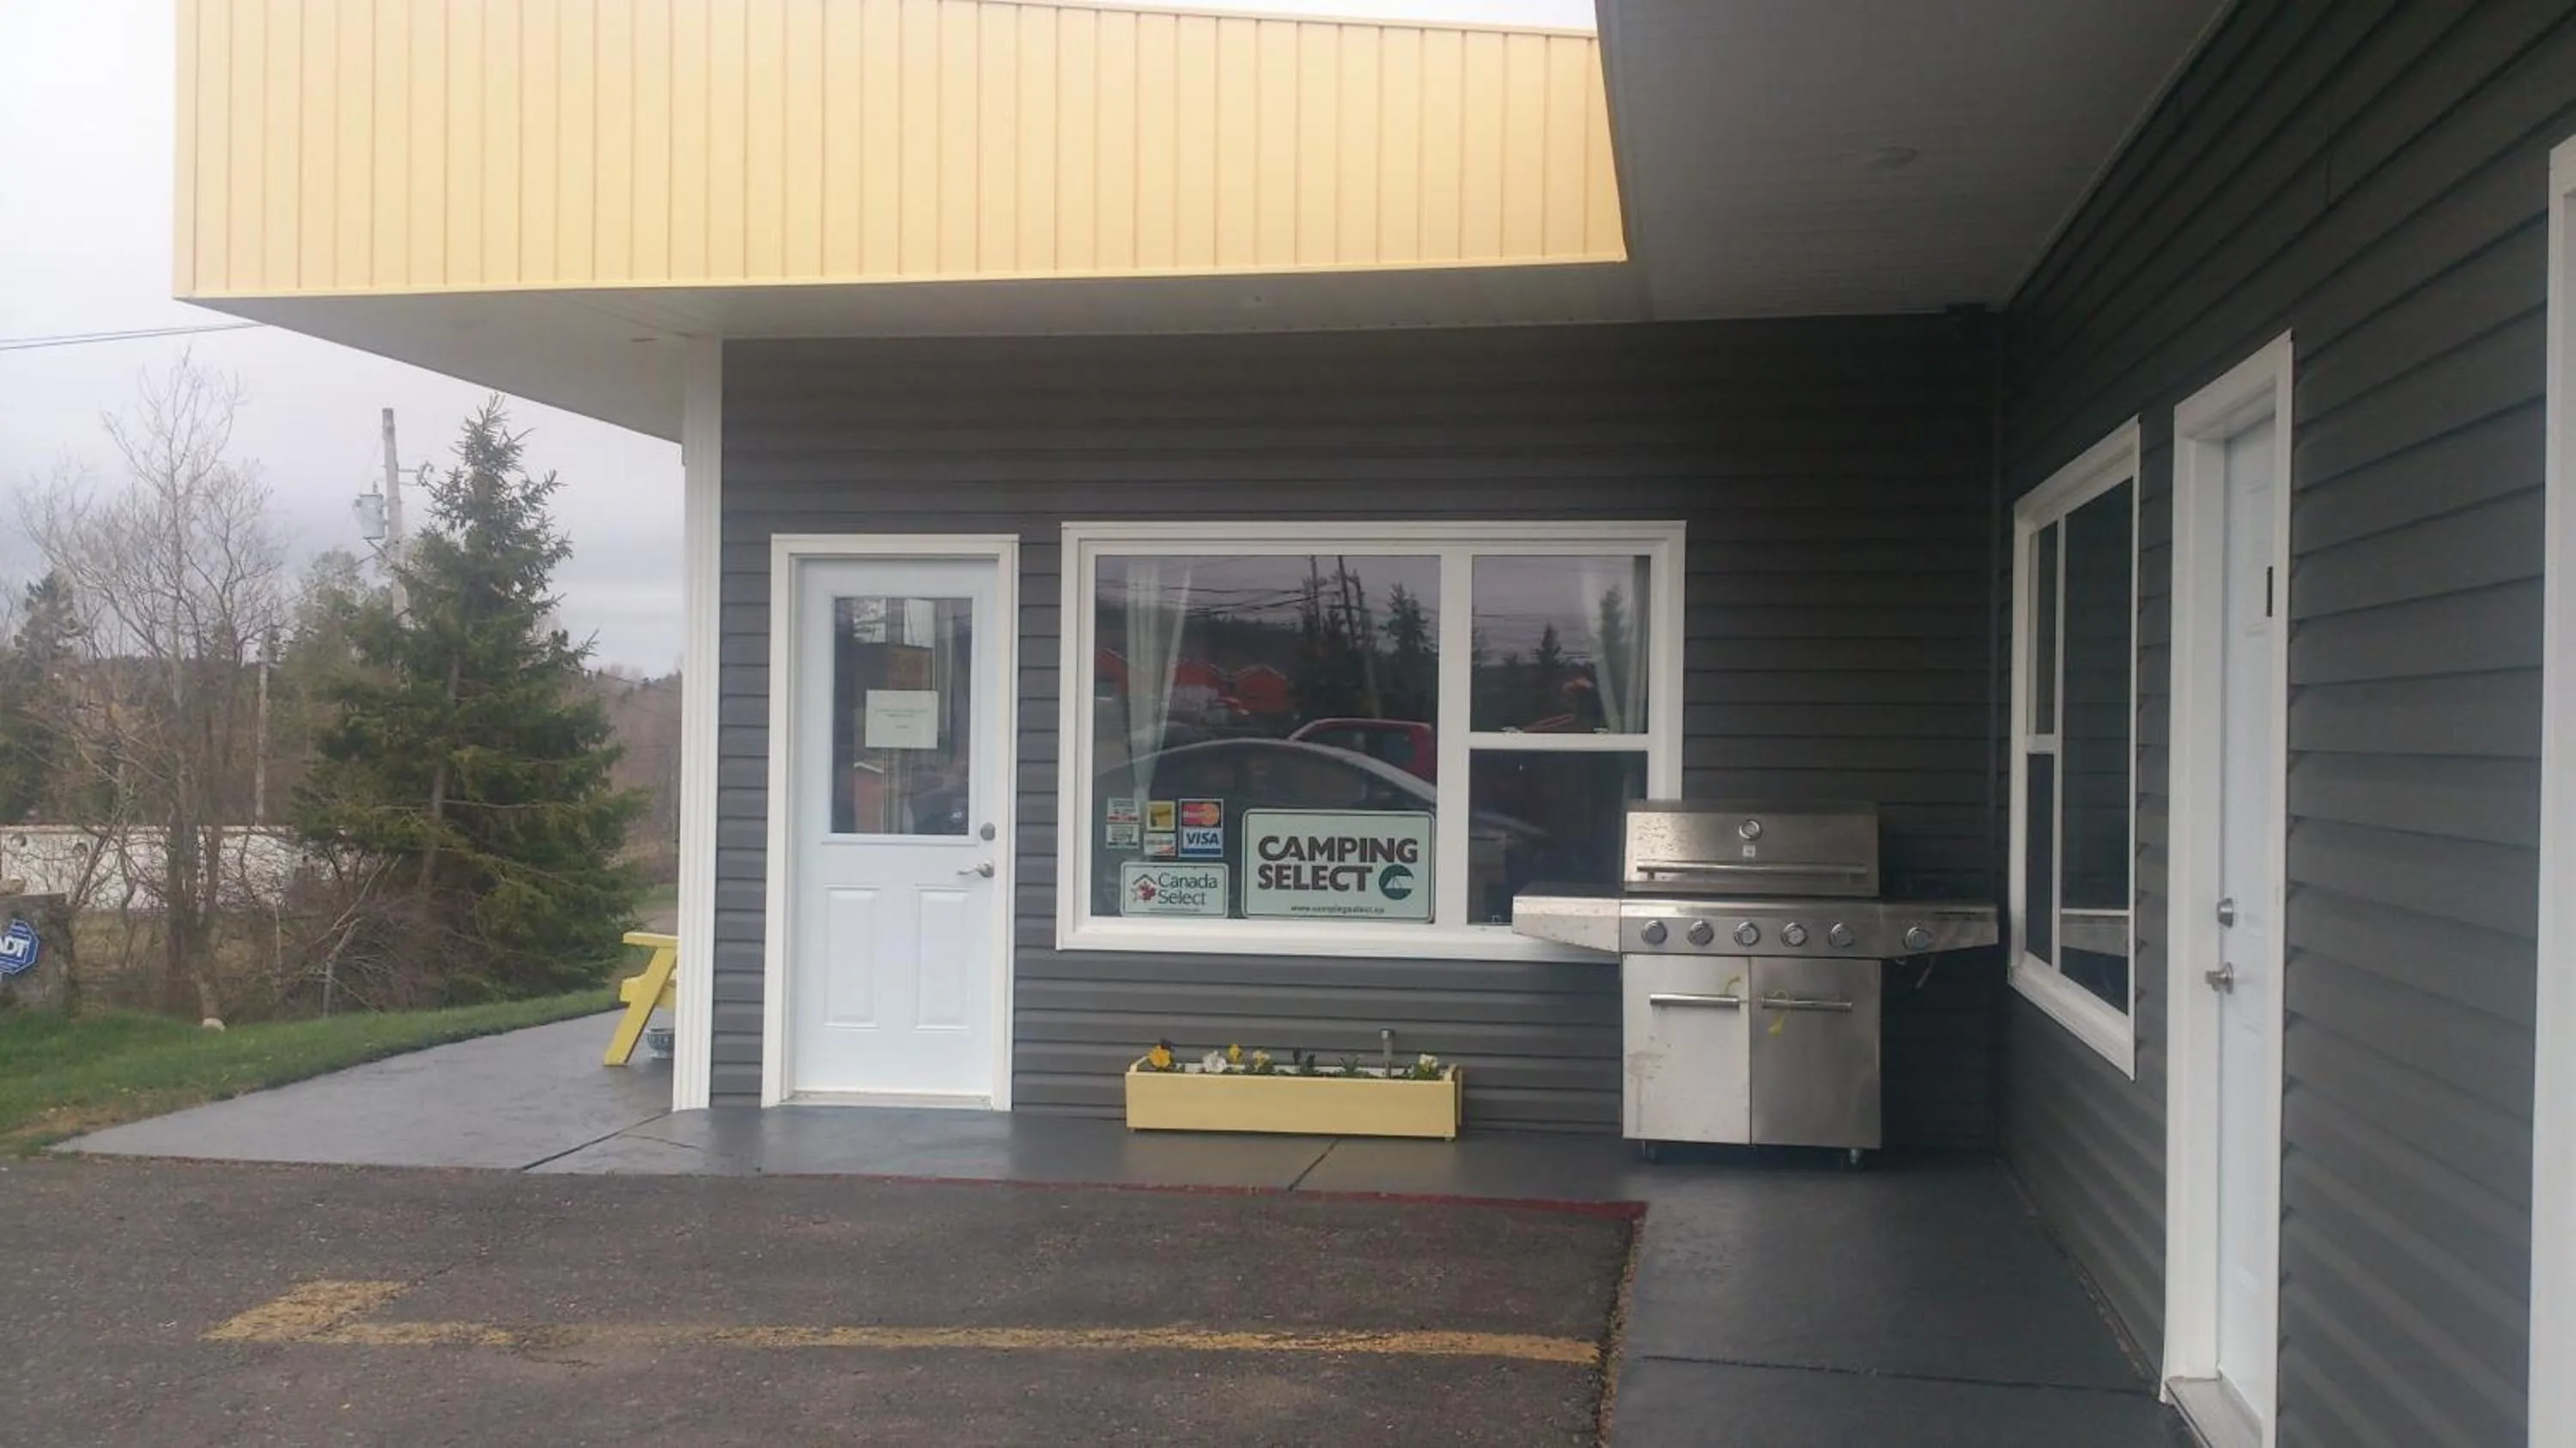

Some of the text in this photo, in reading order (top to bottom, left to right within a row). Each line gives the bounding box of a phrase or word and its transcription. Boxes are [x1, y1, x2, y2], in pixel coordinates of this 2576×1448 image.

[1187, 831, 1218, 844] VISA
[1258, 836, 1418, 863] CAMPING
[1158, 872, 1218, 888] Canada
[1258, 863, 1373, 891] SELECT
[1157, 890, 1206, 905] Select
